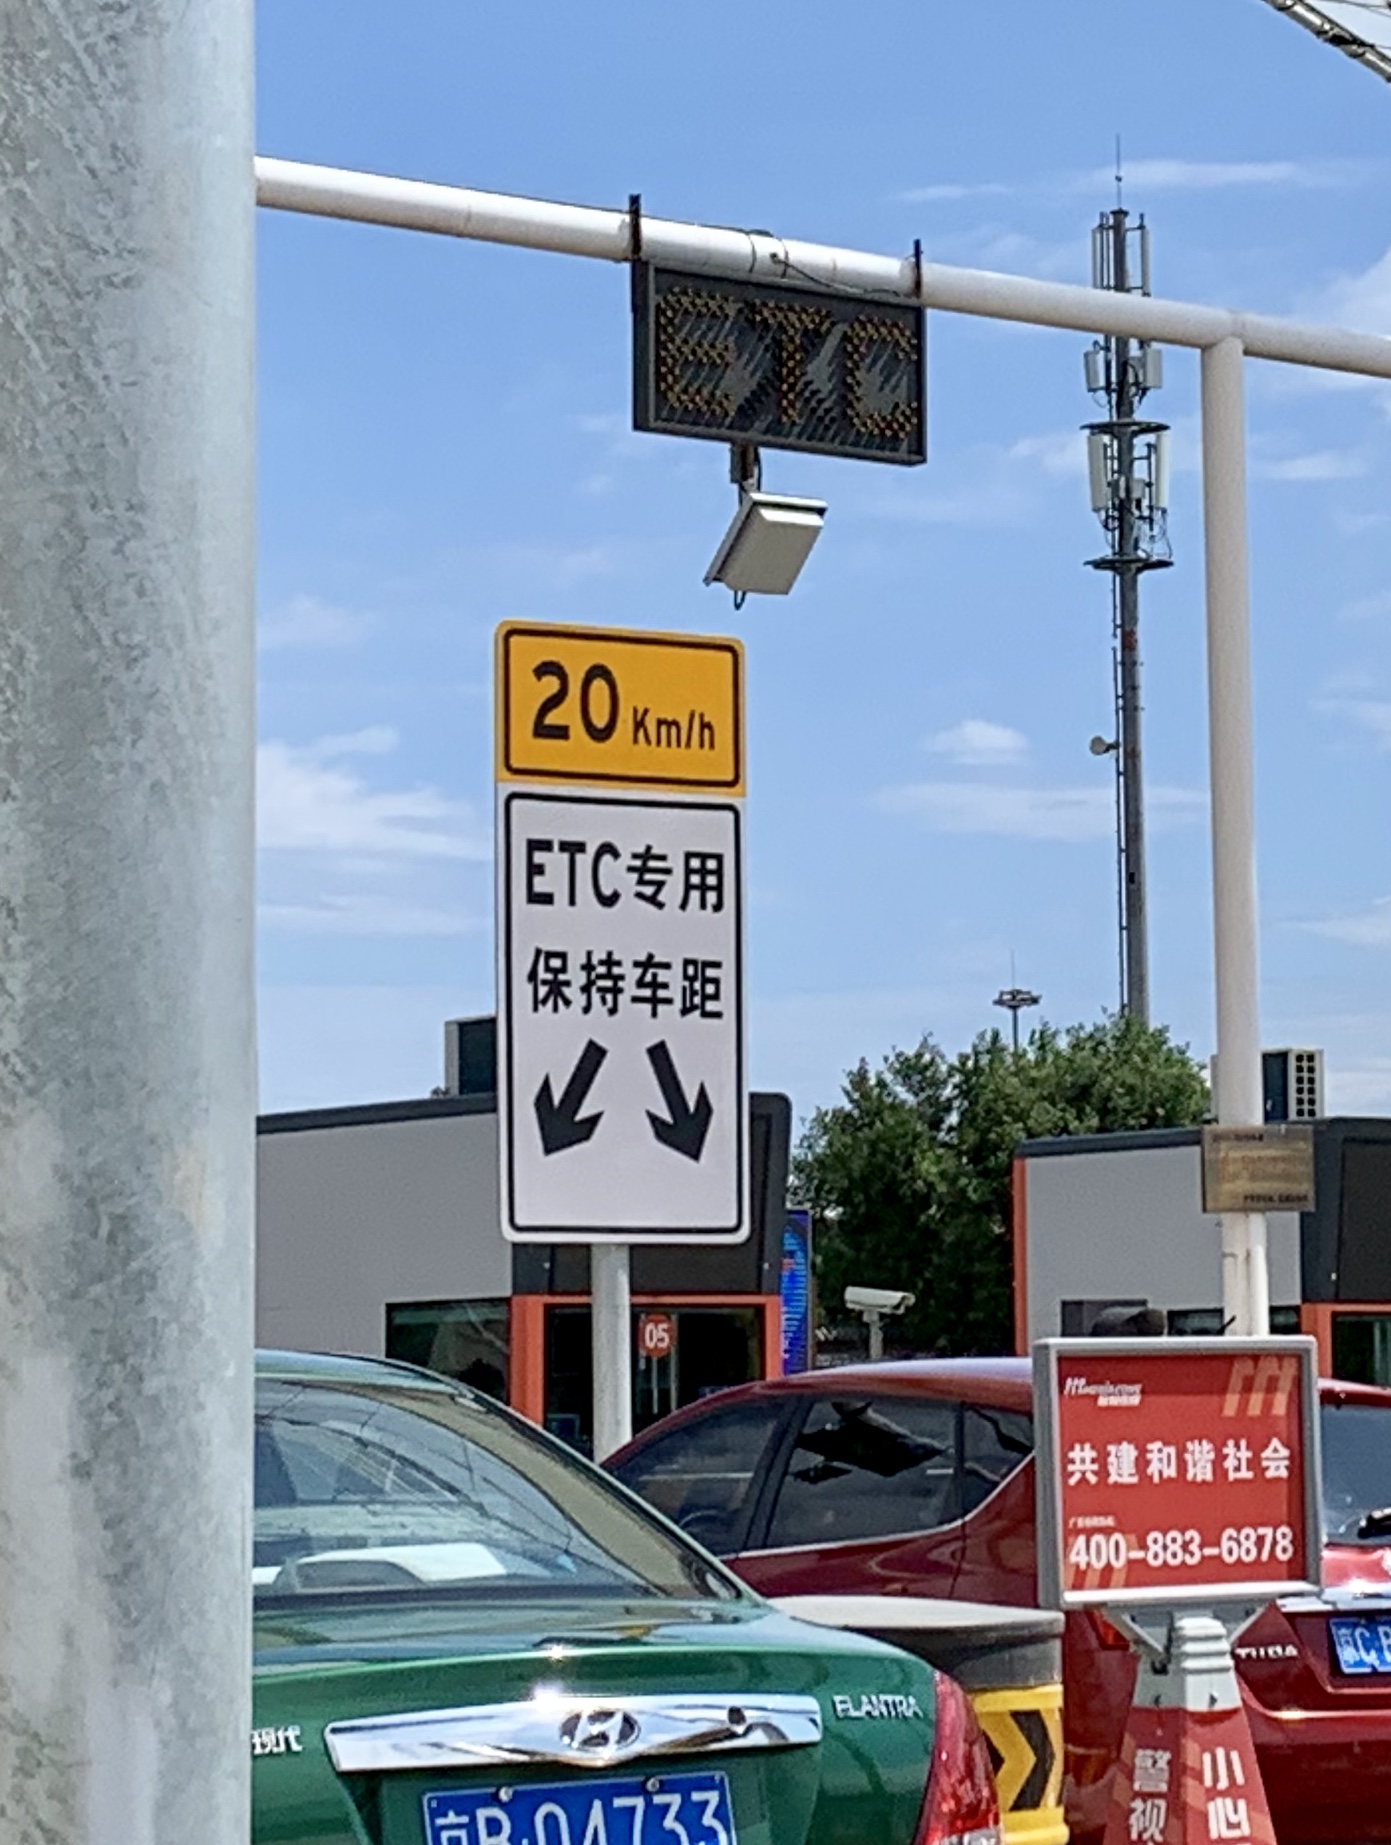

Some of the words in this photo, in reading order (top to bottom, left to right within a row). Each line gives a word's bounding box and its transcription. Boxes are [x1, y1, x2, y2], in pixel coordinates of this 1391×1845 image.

[532, 659, 620, 744] 20
[633, 706, 716, 751] Km/h
[525, 837, 725, 914] ETC专用
[526, 946, 724, 1019] 保持车距
[645, 1322, 670, 1349] 05
[1067, 1437, 1291, 1486] 共建和谐社会
[1068, 1525, 1294, 1571] 400-883-6878
[832, 1694, 924, 1719] ELANTRA
[252, 1725, 303, 1755] 现代
